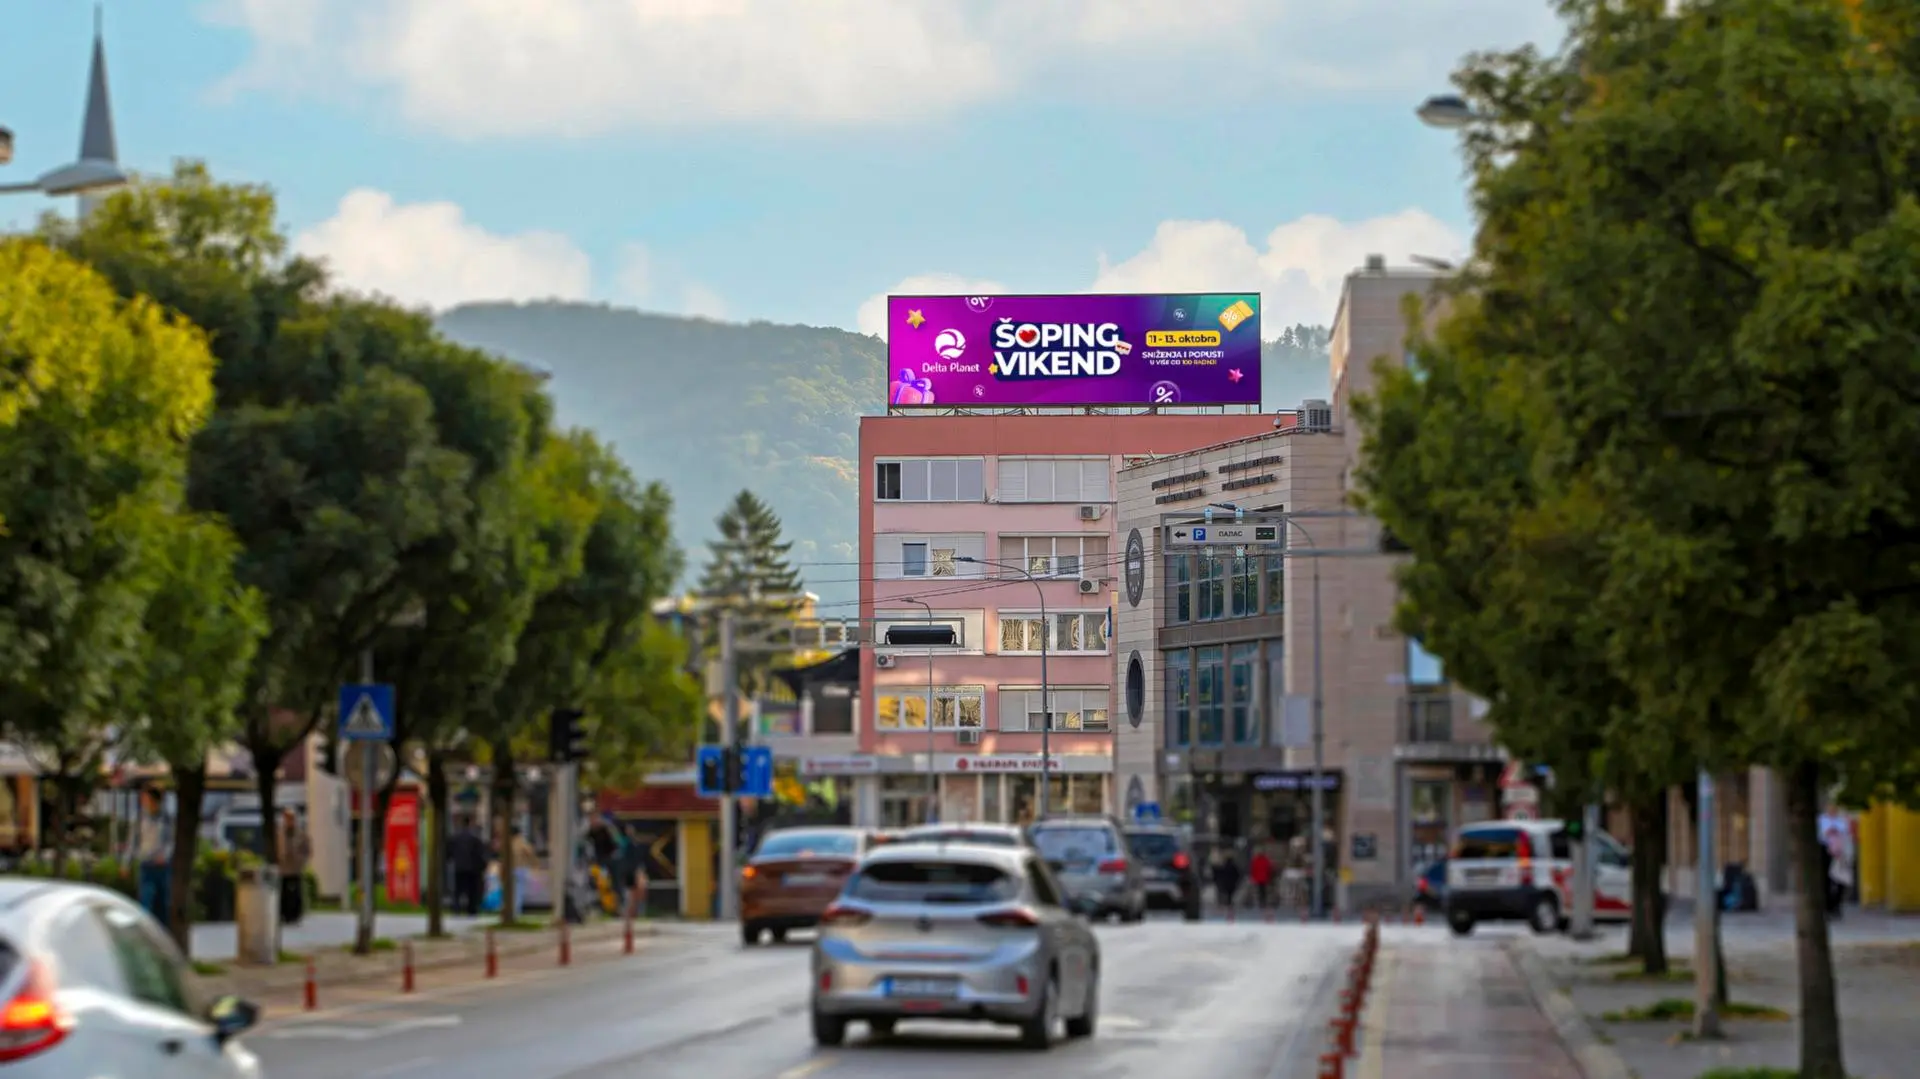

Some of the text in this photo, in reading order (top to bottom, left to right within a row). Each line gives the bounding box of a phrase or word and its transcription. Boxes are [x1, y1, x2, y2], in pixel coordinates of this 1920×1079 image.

[996, 317, 1119, 348] ŠOPING
[1179, 334, 1217, 343] oktobra
[1142, 350, 1182, 358] SNIŽENJA
[922, 362, 979, 373] Delta Planet
[994, 351, 1121, 376] VIKEND
